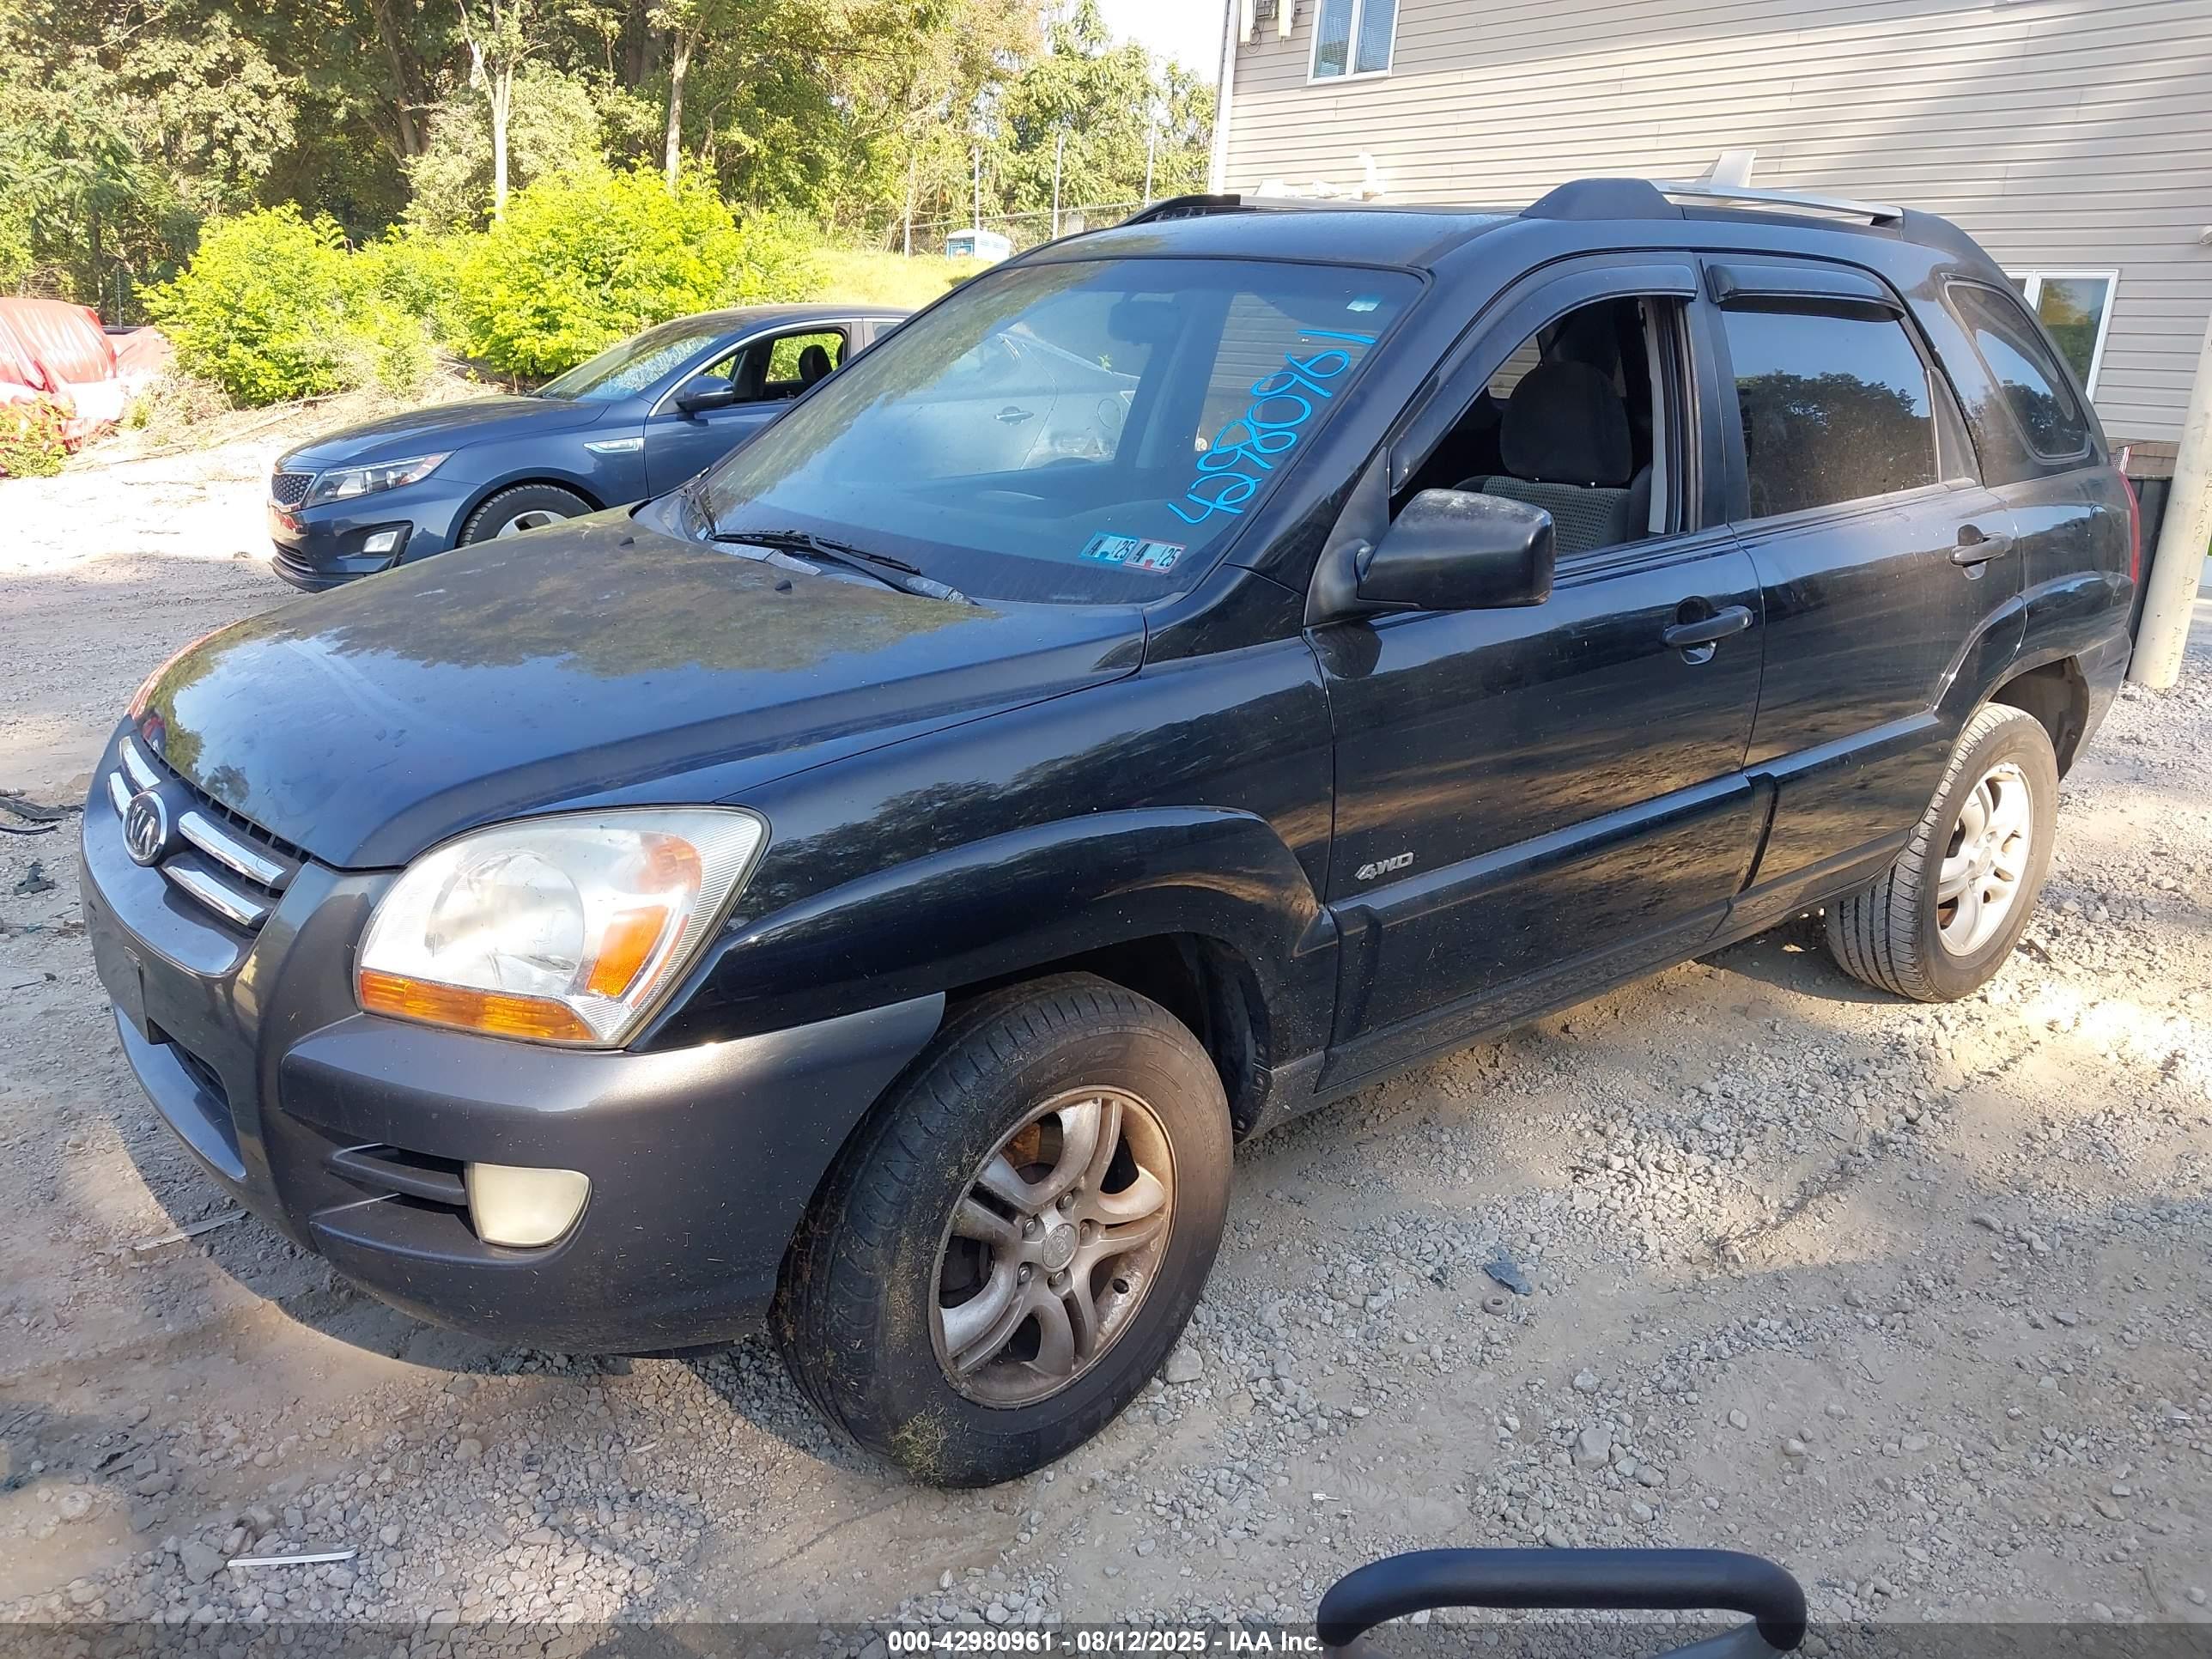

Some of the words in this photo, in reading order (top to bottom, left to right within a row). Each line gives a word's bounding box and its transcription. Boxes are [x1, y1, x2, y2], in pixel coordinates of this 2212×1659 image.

[1088, 539, 1103, 556] 4
[1114, 540, 1136, 560] 25
[1133, 543, 1152, 563] 4
[1159, 548, 1182, 568] 25
[1354, 851, 1414, 880] 4WD
